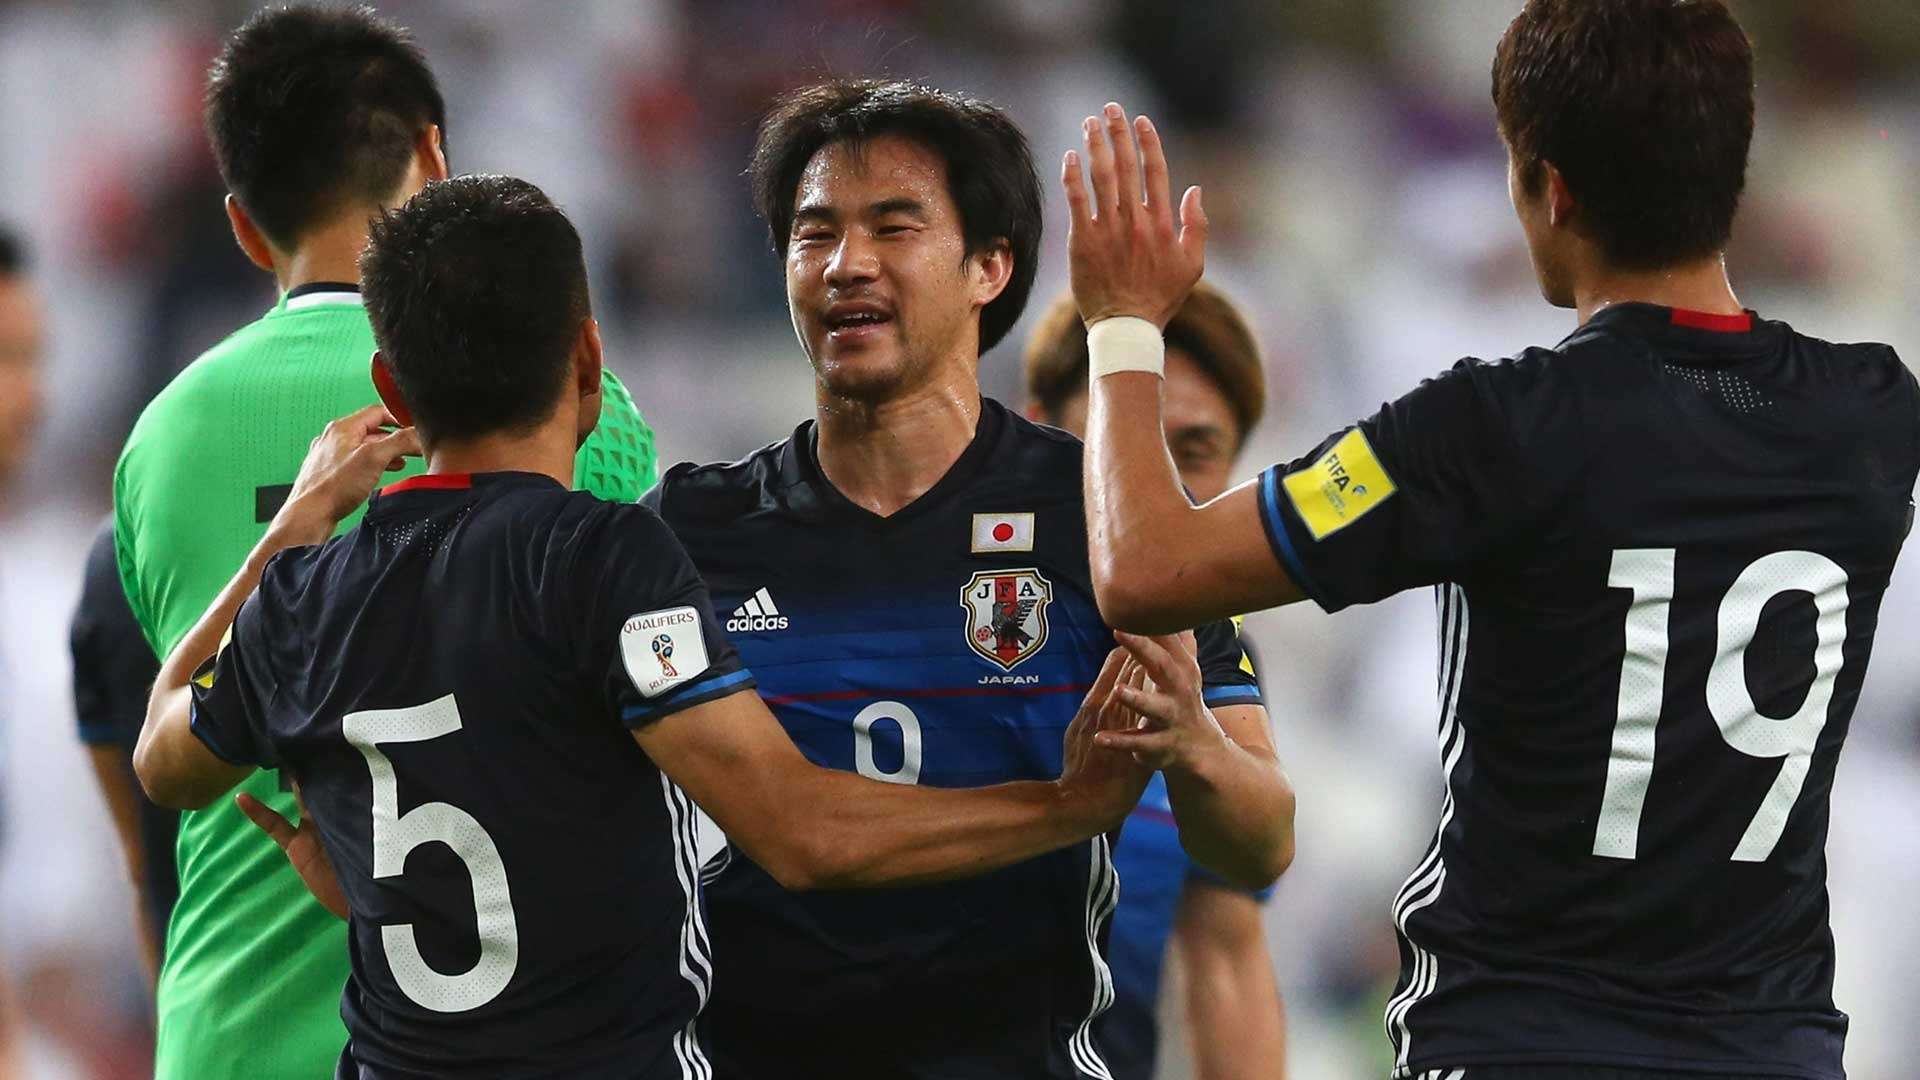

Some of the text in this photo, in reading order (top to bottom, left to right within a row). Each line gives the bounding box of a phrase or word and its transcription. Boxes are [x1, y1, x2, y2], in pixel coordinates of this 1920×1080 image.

[1324, 453, 1351, 492] FIFA
[623, 612, 694, 634] QUALIFIERS
[726, 614, 789, 632] adidas
[977, 675, 1040, 684] JAPAN
[1592, 548, 1850, 862] 19
[342, 693, 519, 1013] 5
